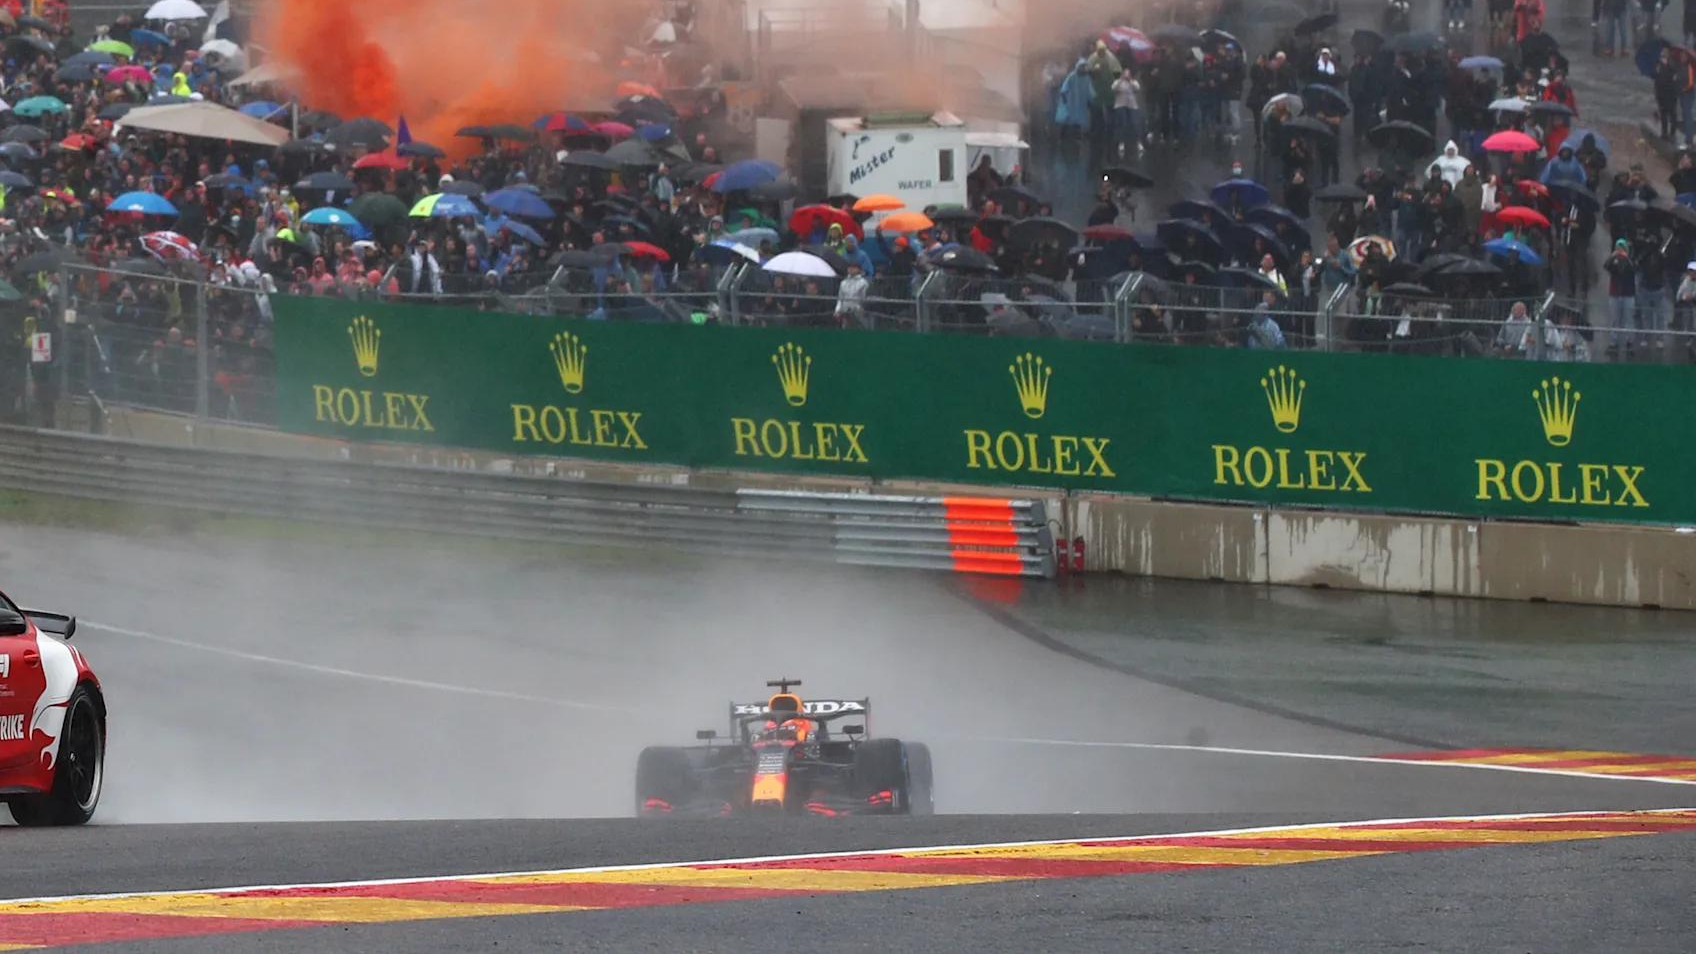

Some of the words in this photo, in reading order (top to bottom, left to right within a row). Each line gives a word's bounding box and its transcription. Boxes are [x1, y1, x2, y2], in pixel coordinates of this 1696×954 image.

[849, 146, 896, 185] Mister
[312, 384, 436, 432] ROLEX
[510, 404, 649, 450] ROLEX
[731, 417, 869, 463] ROLEX
[963, 429, 1117, 478] ROLEX
[1211, 444, 1373, 493] ROLEX
[1474, 458, 1651, 507] ROLEX
